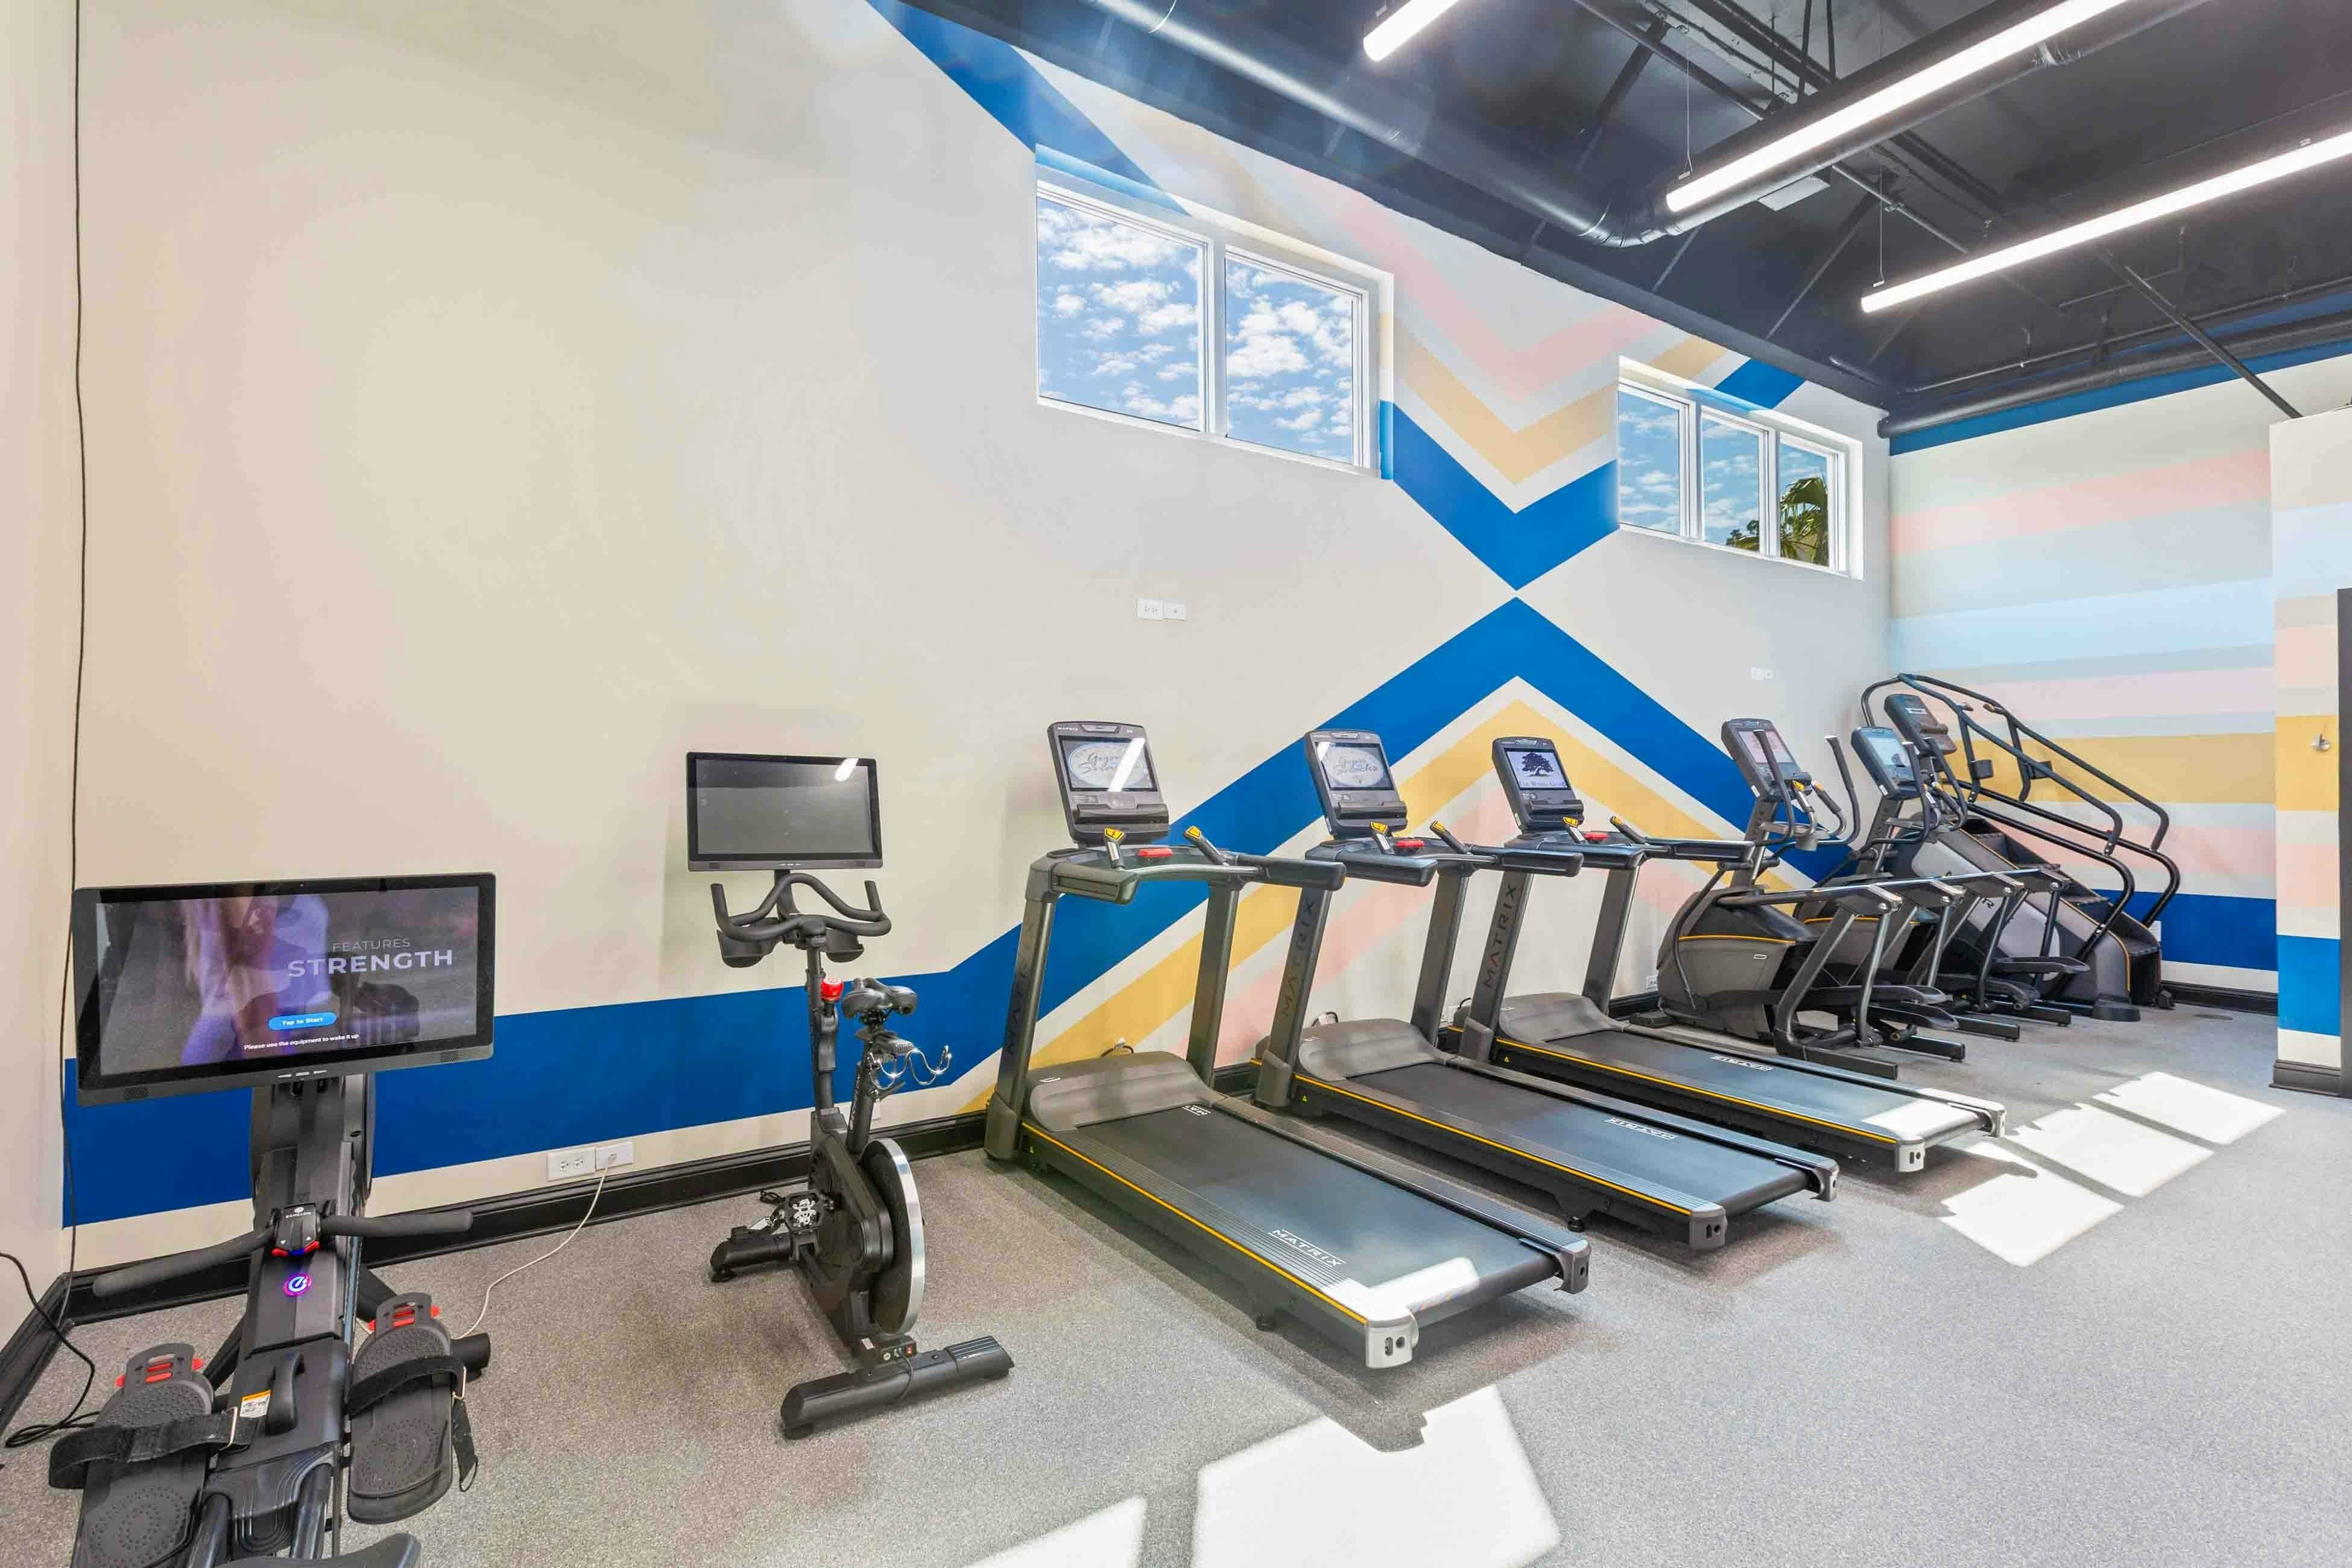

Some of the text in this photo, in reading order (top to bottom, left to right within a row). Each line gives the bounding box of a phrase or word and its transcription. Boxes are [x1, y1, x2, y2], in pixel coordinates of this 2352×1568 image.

[332, 938, 411, 952] FEATURES
[1484, 883, 1517, 988] MATRIX
[287, 949, 452, 977] STRENGTH
[1272, 1230, 1342, 1266] MATRIX
